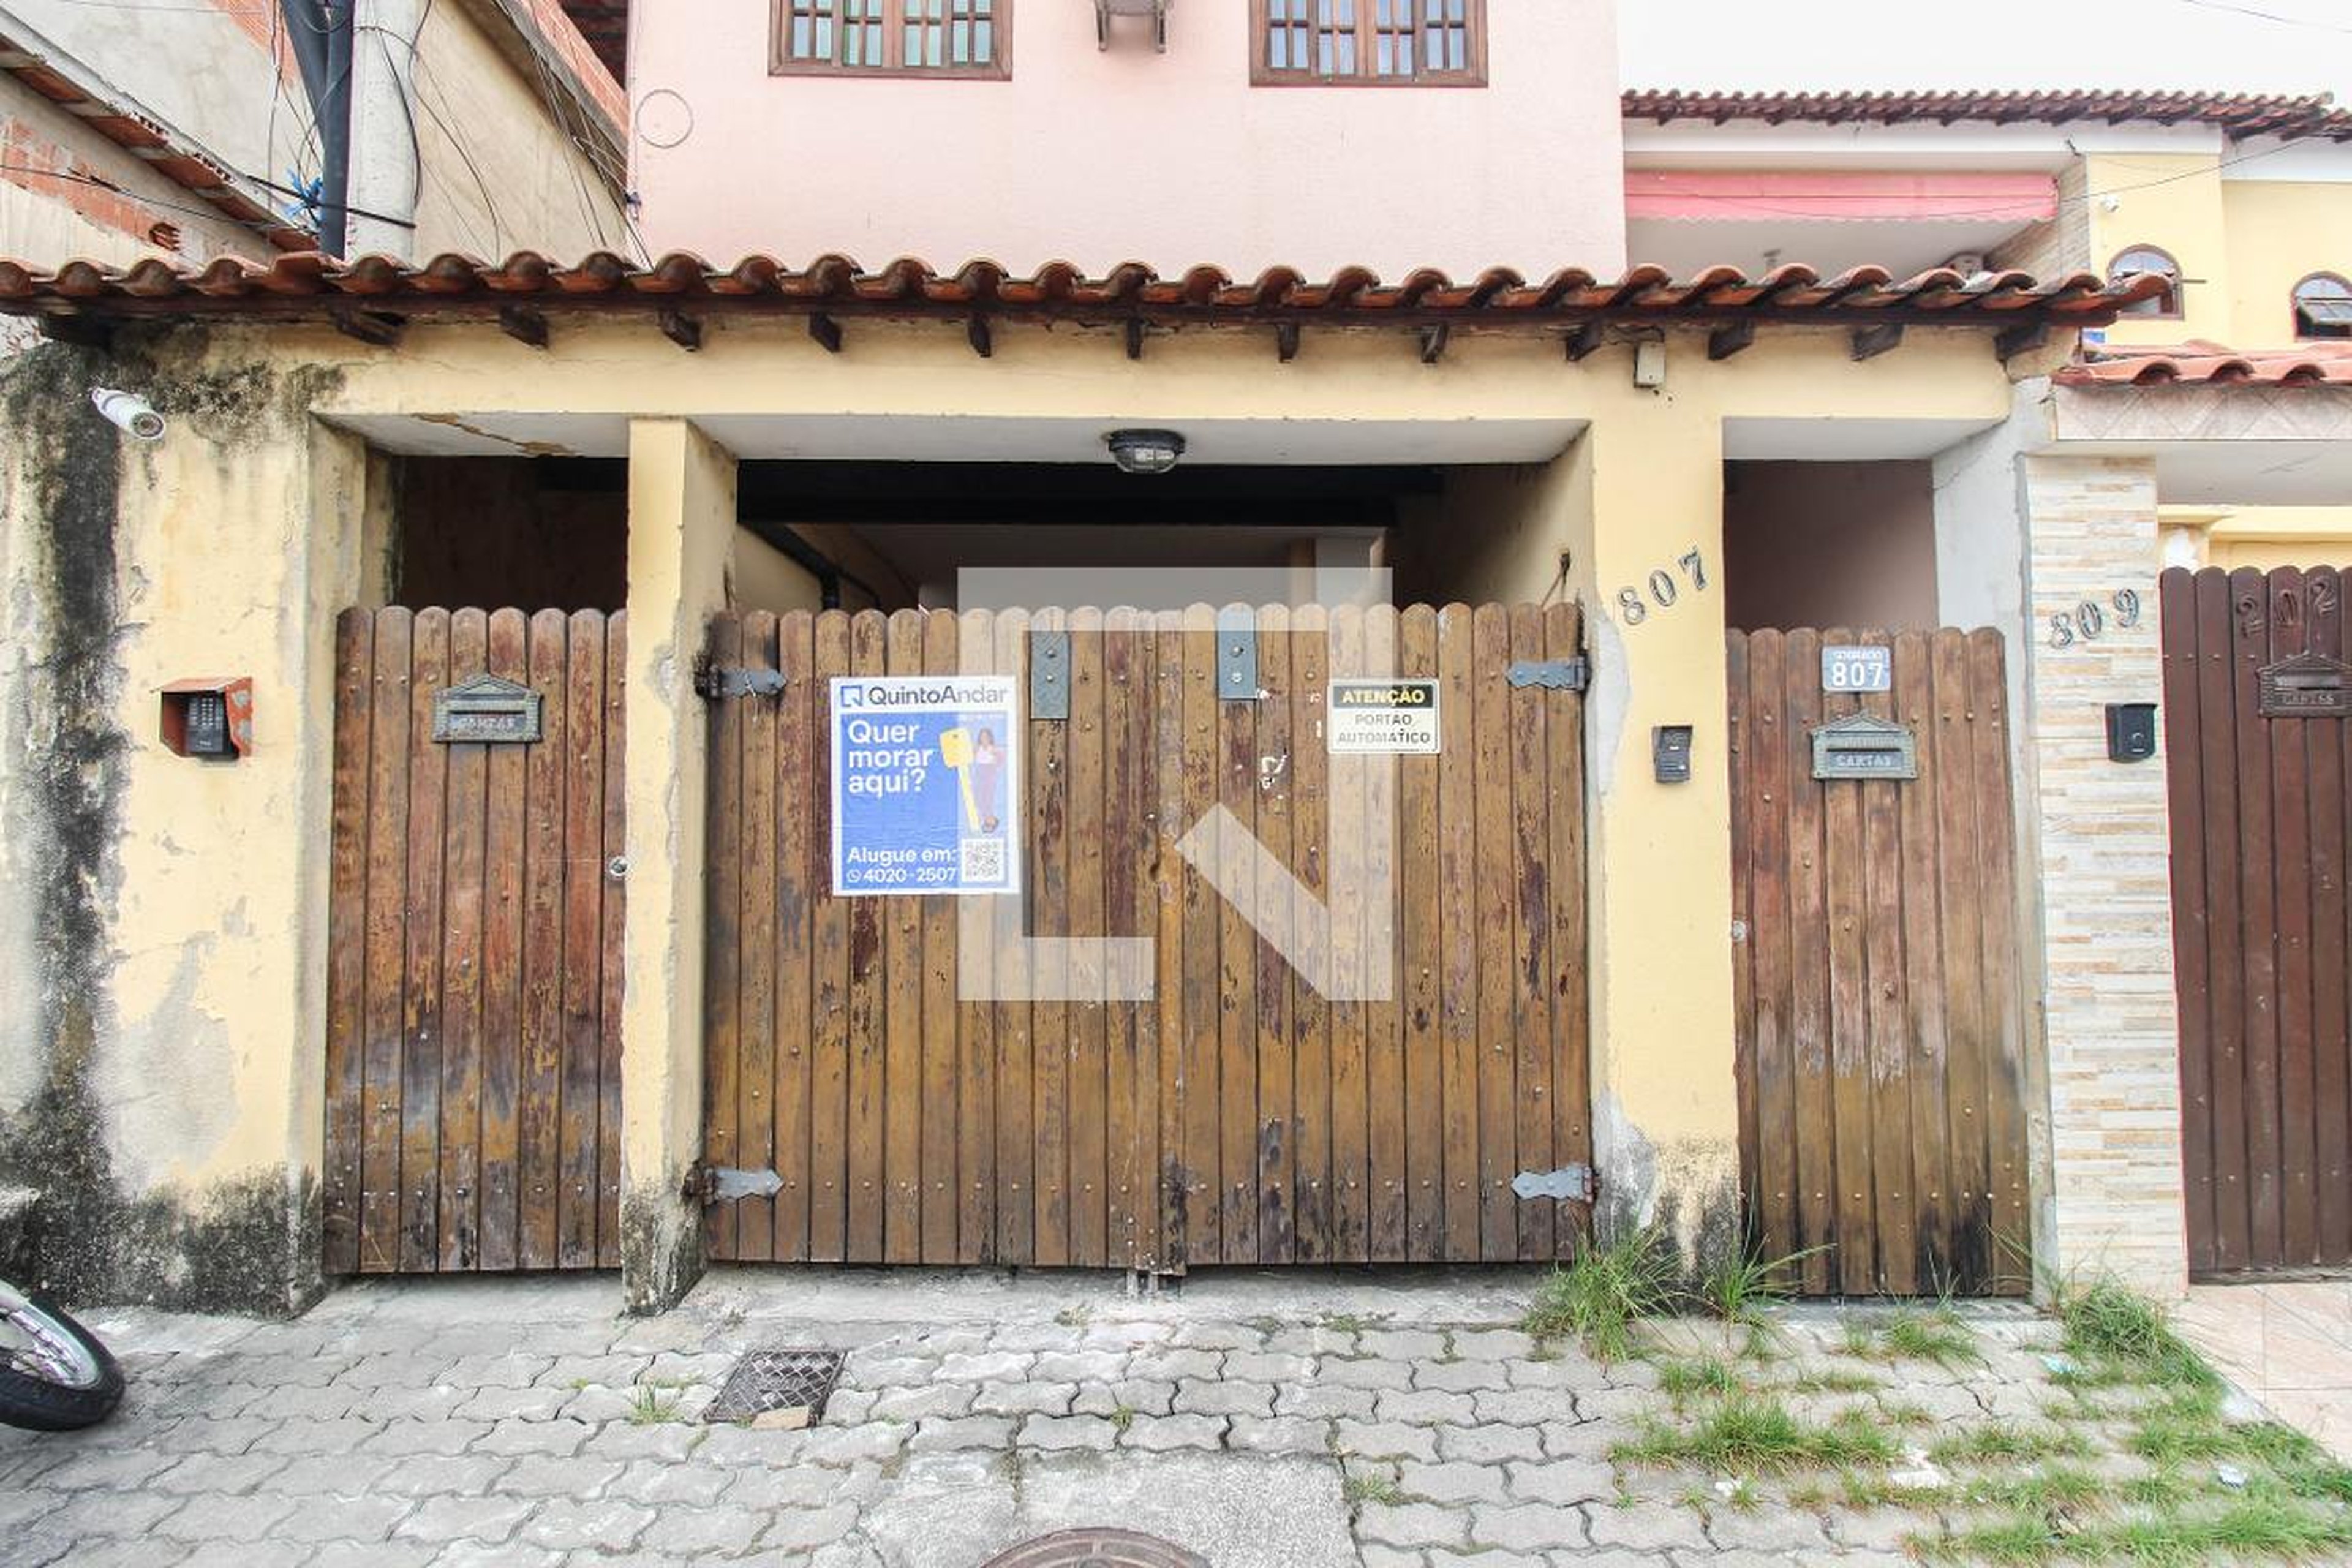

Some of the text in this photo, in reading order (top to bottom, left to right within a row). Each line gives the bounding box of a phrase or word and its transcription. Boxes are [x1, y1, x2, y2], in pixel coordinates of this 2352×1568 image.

[1617, 544, 1707, 626] 807
[2051, 588, 2139, 649] 809
[2237, 576, 2335, 638] 202
[1833, 662, 1882, 687] 807
[869, 686, 1008, 705] QuintoAndar
[848, 720, 919, 743] Quer
[848, 749, 932, 768] morar
[848, 769, 926, 797] aqui?
[847, 847, 917, 866] Alugue
